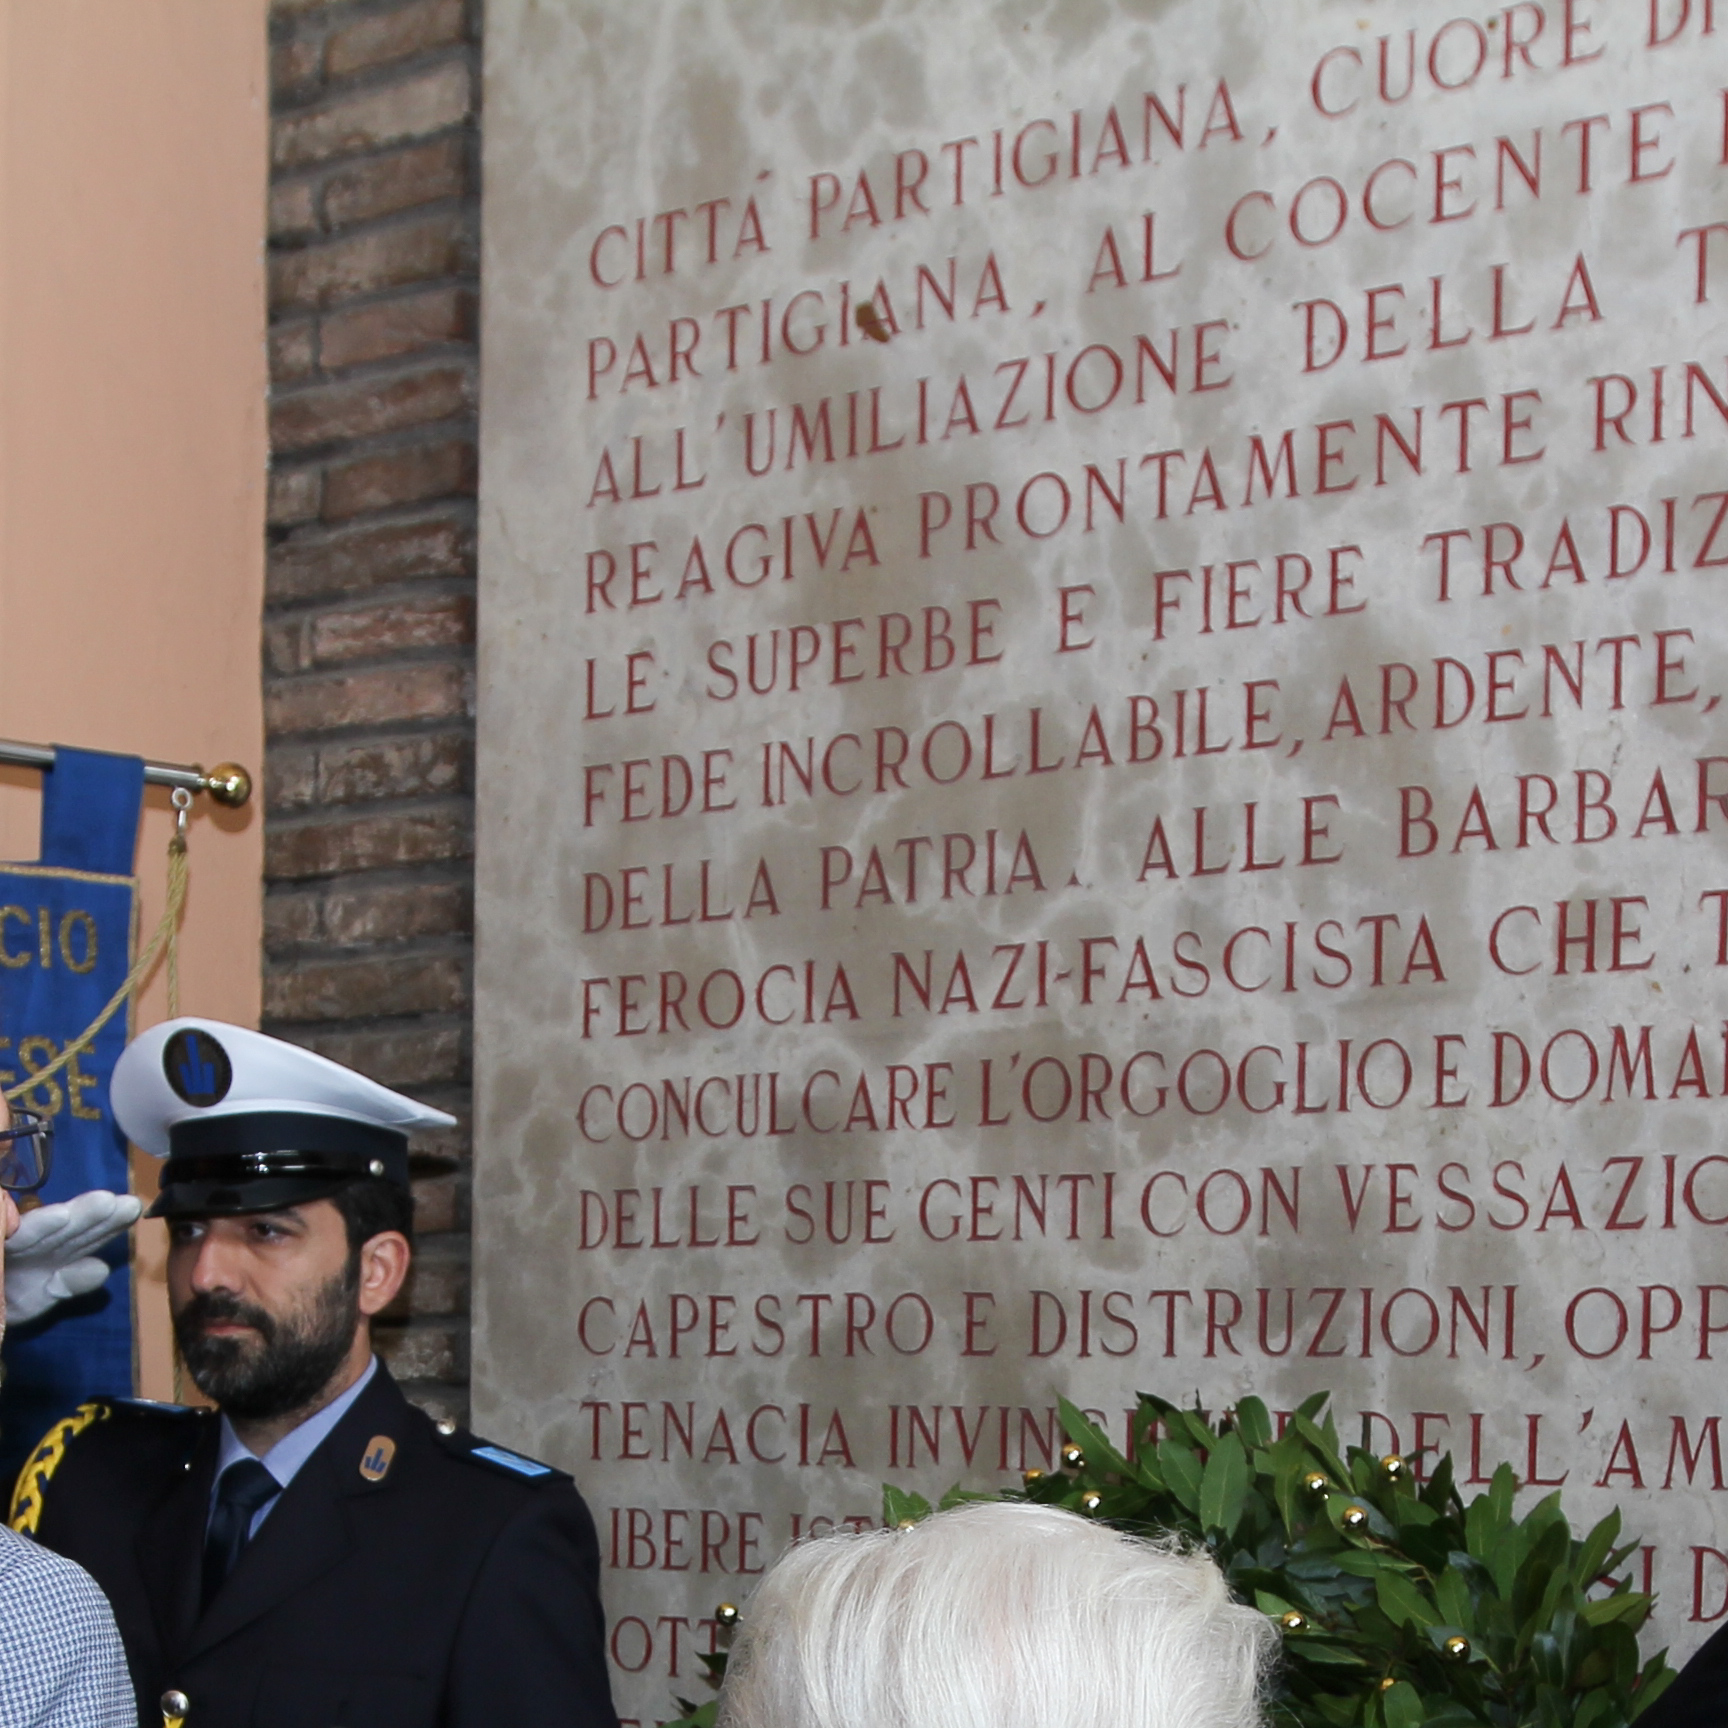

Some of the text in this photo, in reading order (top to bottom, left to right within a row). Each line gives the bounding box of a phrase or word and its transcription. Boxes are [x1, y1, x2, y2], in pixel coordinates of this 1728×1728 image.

[808, 79, 1277, 243] PARTIGIANA,
[1309, 0, 1601, 120] CUORE
[587, 253, 1046, 403] PARTIGIANA,
[1086, 214, 1180, 296] AL
[1222, 104, 1674, 264] COCENTE
[586, 321, 1232, 509] ALL'UMILIAZIONE
[1294, 255, 1602, 374] DELLA
[584, 507, 884, 616] REAGIVA
[916, 390, 1545, 561] PRONTAMENTE
[583, 651, 657, 723] LE
[706, 599, 1004, 703] SUPERBE
[1057, 585, 1096, 654] E
[1152, 546, 1366, 642] FIERE
[583, 750, 736, 828] FEDE
[761, 680, 1304, 808] INCROLLABILE,
[1320, 630, 1721, 743] ARDENTE,
[583, 858, 781, 935] DELLA
[819, 829, 1079, 912] PATRIA,
[1136, 794, 1342, 883] ALLE
[581, 961, 862, 1040] FEROCIA
[891, 914, 1447, 1018] NAZI-FASCISTA
[1488, 896, 1655, 976] CHE
[577, 1063, 956, 1144] CONCULCARE
[977, 1038, 1413, 1128] L'ORGOGLIO
[1430, 1035, 1467, 1109] E
[577, 1186, 759, 1252] DELLE
[785, 1180, 894, 1245] SUE
[918, 1173, 1115, 1243] GENTI
[1139, 1167, 1300, 1237] CON
[578, 1294, 934, 1359] CAPESTRO
[960, 1292, 999, 1358] E
[1028, 1286, 1545, 1370] DISTRUZIONI,
[581, 1401, 855, 1469] TENACIA
[610, 1509, 762, 1574] IBERE
